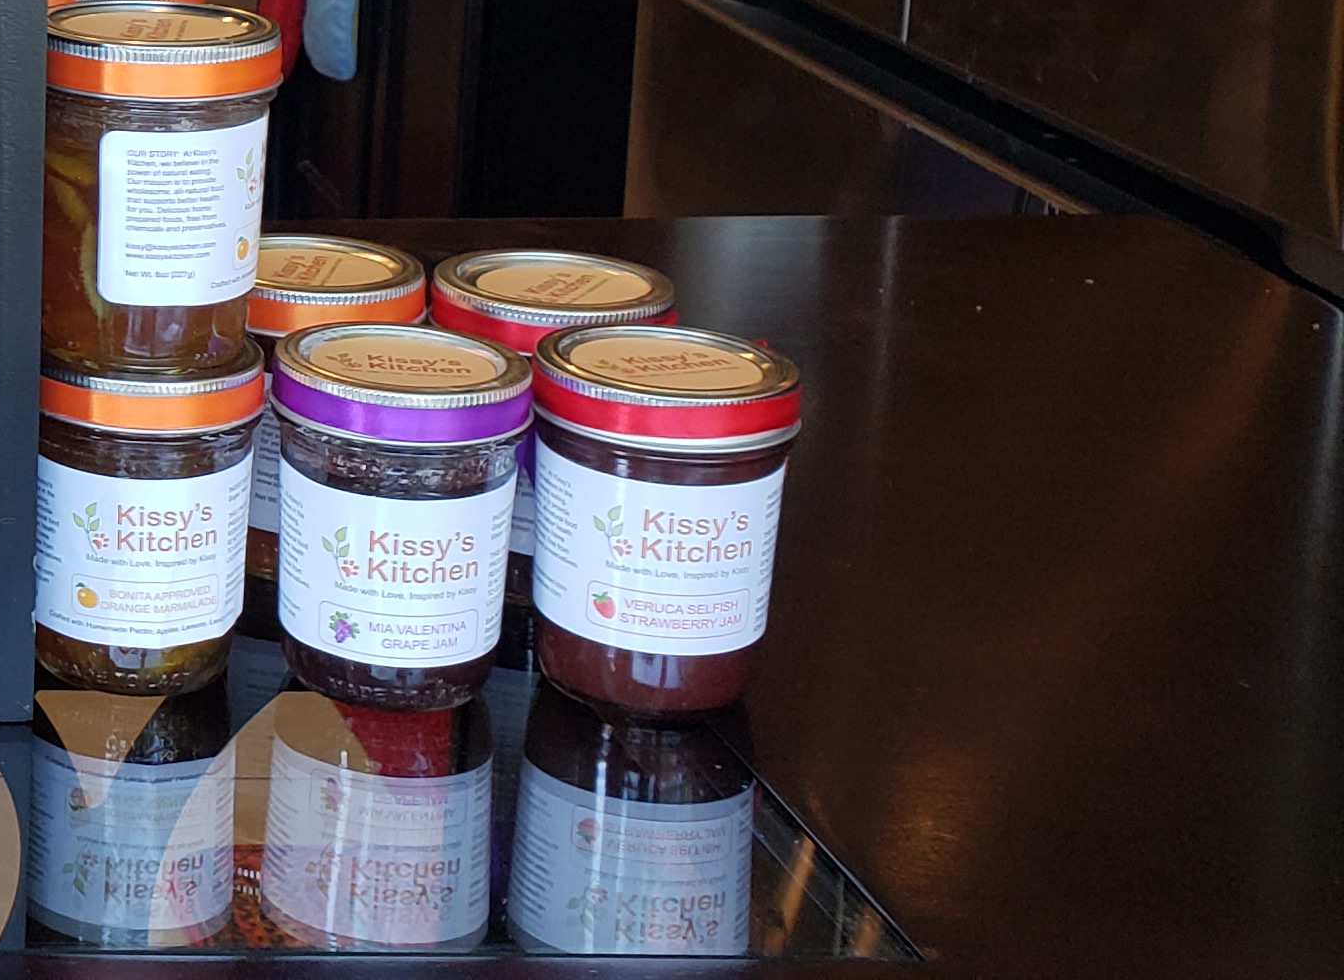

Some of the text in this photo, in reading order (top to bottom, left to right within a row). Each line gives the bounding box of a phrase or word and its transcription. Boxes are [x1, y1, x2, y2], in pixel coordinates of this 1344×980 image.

[367, 353, 462, 367] Kissy's
[367, 362, 472, 375] Kitchen
[116, 502, 213, 531] Kissy's
[643, 509, 749, 541] Kissy's
[116, 529, 217, 552] Kitchen
[368, 530, 475, 562] Kissy's
[641, 537, 752, 563] Kitchen
[368, 558, 479, 584] Kitchen
[109, 585, 210, 601] BONITA APPROVED
[101, 596, 217, 613] ORANGE MARMALADE
[624, 598, 739, 615] VERUCA SELFISH
[86, 622, 128, 633] Homemade
[369, 621, 467, 636] MIA VALENTINA
[620, 612, 742, 631] STRAWBERRY JAM
[381, 637, 458, 650] GRAPE JAM
